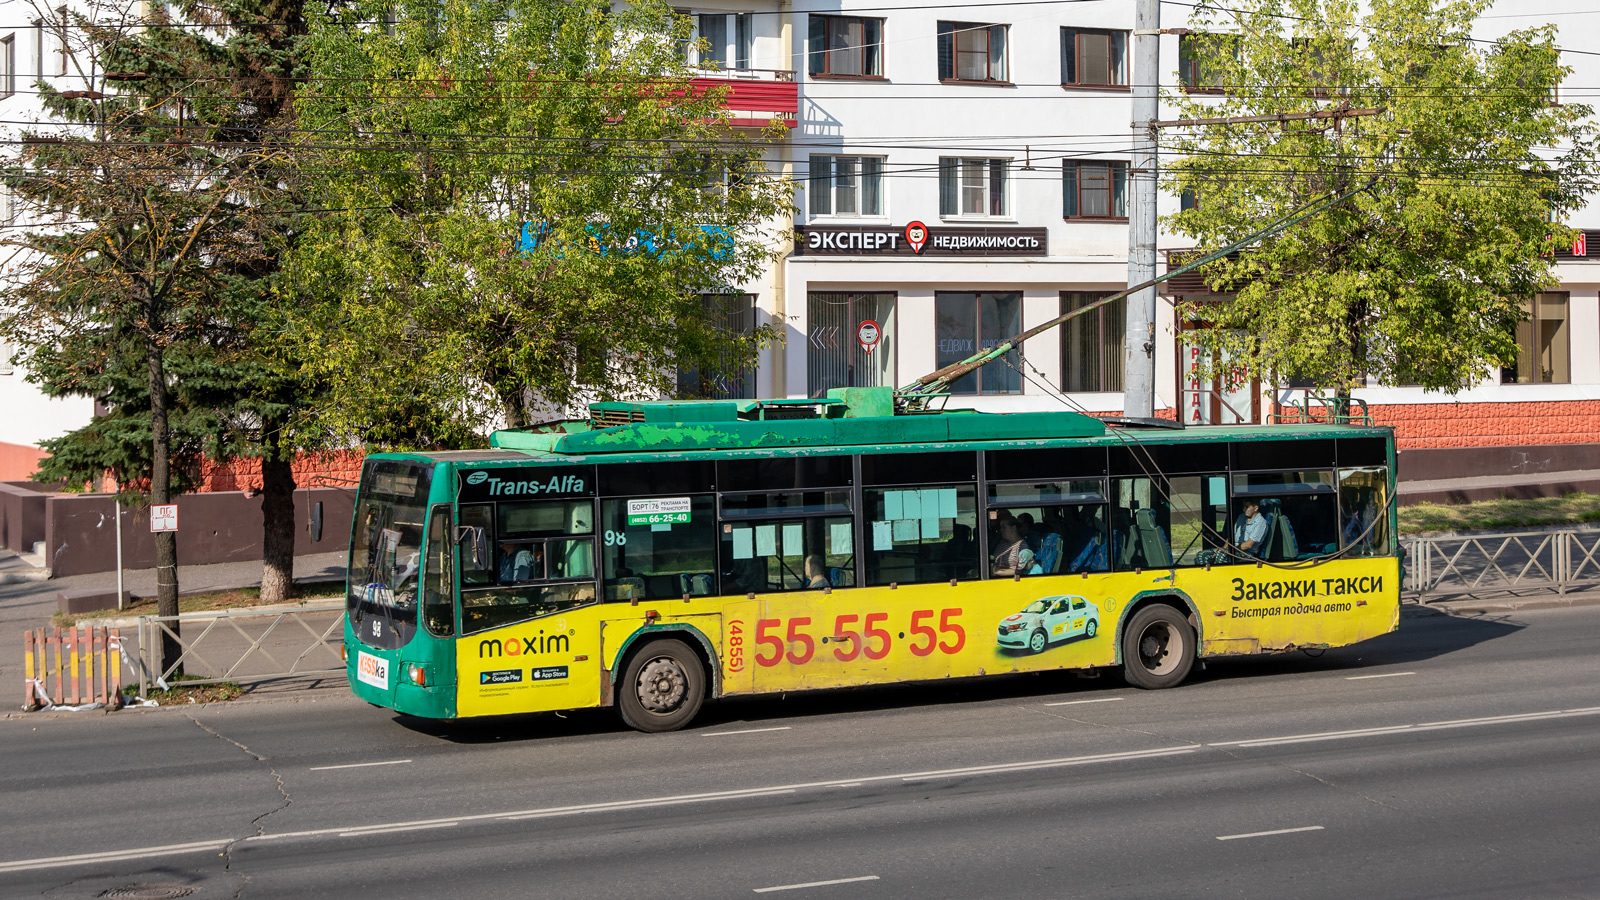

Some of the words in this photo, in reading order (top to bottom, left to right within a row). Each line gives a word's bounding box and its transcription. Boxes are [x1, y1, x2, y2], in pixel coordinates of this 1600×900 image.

[808, 231, 900, 249] ЭКСПЕРТ
[933, 236, 1039, 250] НЕДВИЖИМОСТЬ
[487, 475, 585, 496] Trans-Alfa
[648, 514, 687, 522] 66-25-40
[604, 529, 626, 546] 98
[1231, 577, 1316, 601] Закажи
[1322, 576, 1383, 596] такси
[1231, 606, 1281, 619] Быстрая
[1283, 602, 1321, 616] подача
[1324, 602, 1352, 612] авто
[728, 619, 745, 672] (4855)
